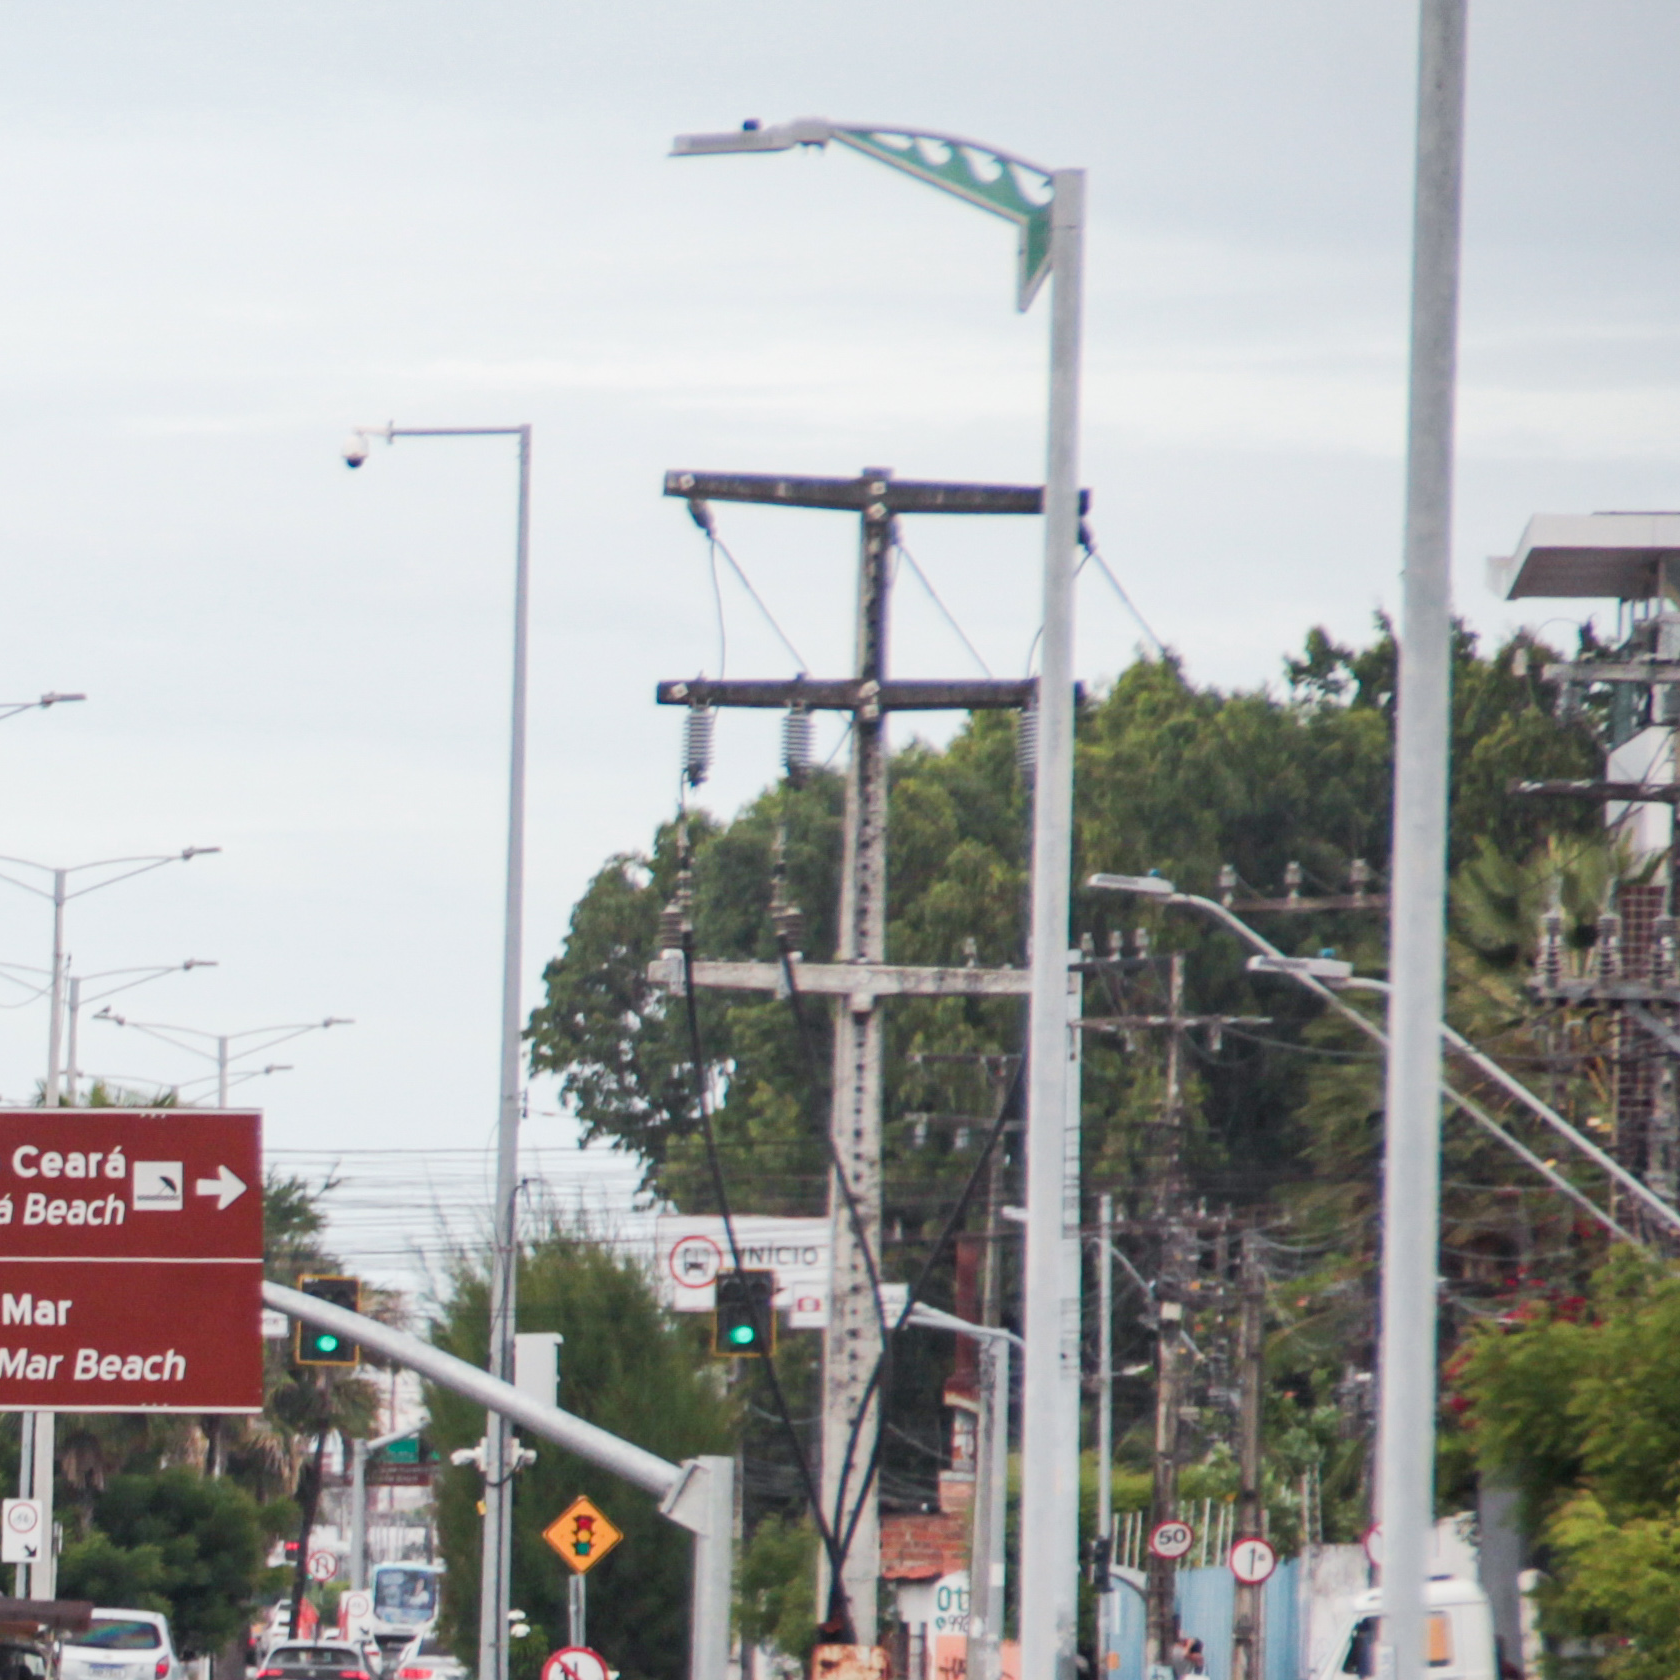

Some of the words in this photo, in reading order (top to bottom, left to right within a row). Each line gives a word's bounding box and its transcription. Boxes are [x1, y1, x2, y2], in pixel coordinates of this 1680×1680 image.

[12, 1145, 127, 1179] Ceará
[22, 1192, 127, 1227] Beach
[1, 1293, 72, 1326] Mar
[73, 1349, 187, 1381] Beach
[1159, 1529, 1186, 1545] 50
